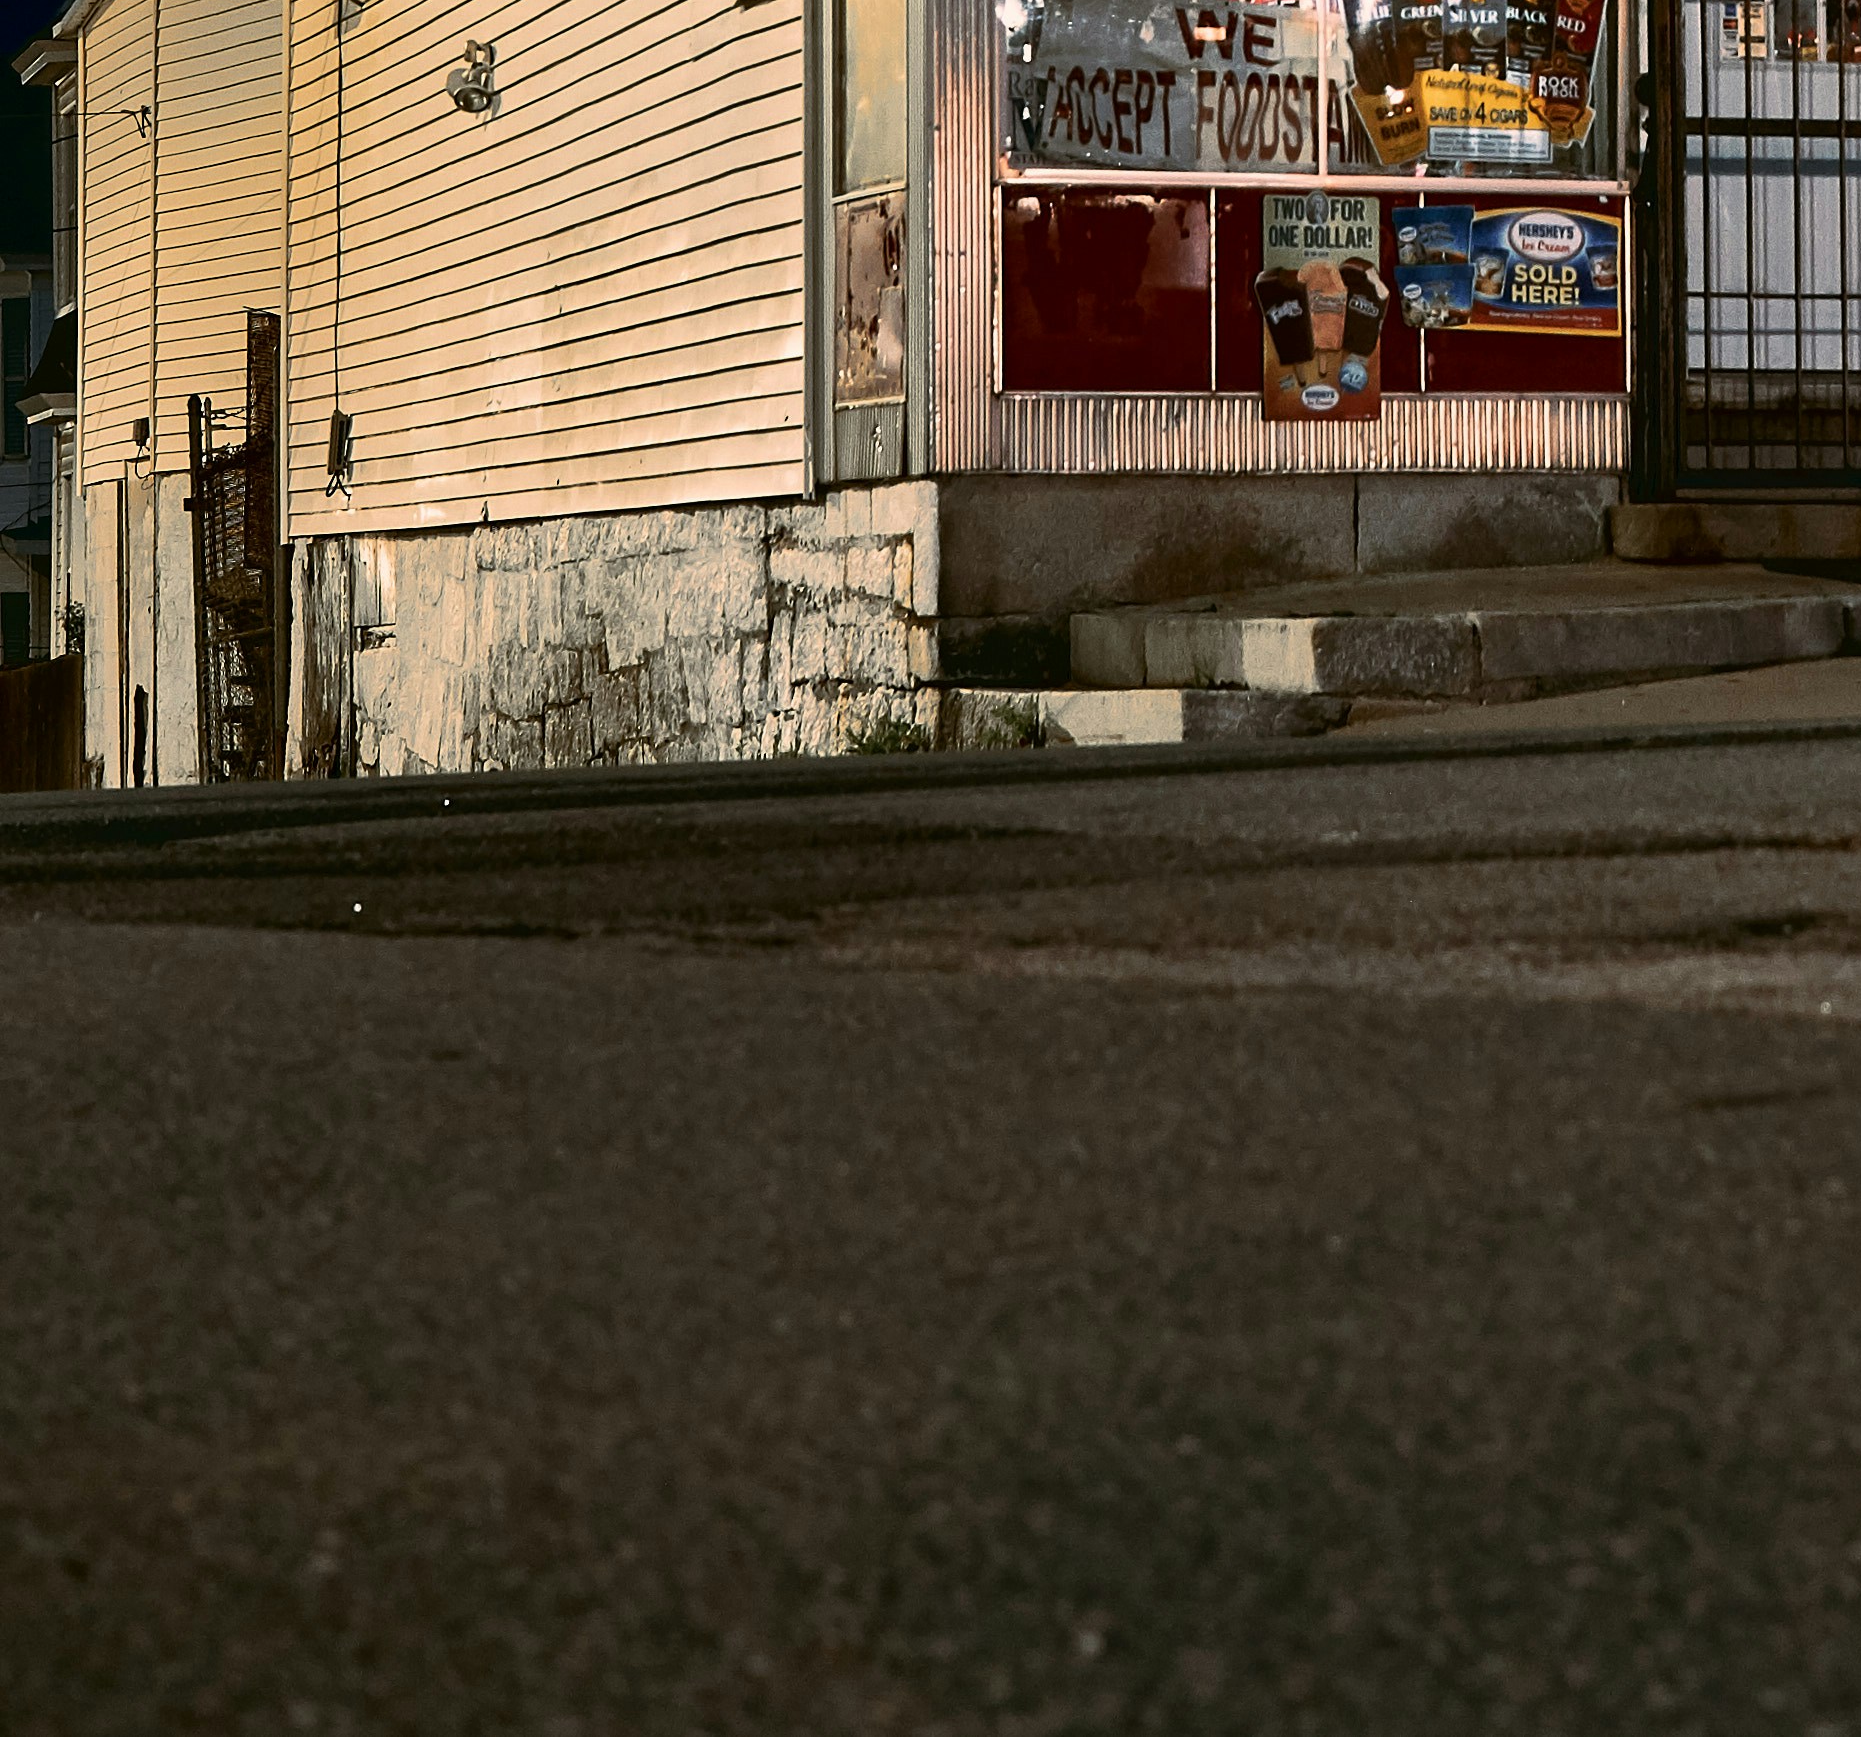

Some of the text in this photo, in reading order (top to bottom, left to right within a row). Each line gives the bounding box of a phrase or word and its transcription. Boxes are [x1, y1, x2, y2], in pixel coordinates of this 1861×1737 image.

[1400, 4, 1444, 20] GREEN
[1450, 8, 1499, 24] SILVER
[1505, 5, 1548, 24] BLACK
[1557, 14, 1586, 34] RED
[1175, 6, 1282, 67] WE
[1538, 75, 1579, 88] ROCK
[1048, 65, 1176, 157] ACCEPT
[1429, 106, 1457, 122] SAVE
[1475, 102, 1487, 124] 4
[1489, 107, 1529, 125] CIGARS
[1272, 197, 1365, 222] TWO FOR
[1268, 224, 1373, 249] ONE DOLLAR!
[1518, 222, 1574, 240] HERSHEY'S
[1537, 239, 1571, 254] Cream
[1514, 263, 1578, 284] SOLD
[1511, 283, 1581, 306] HERE!
